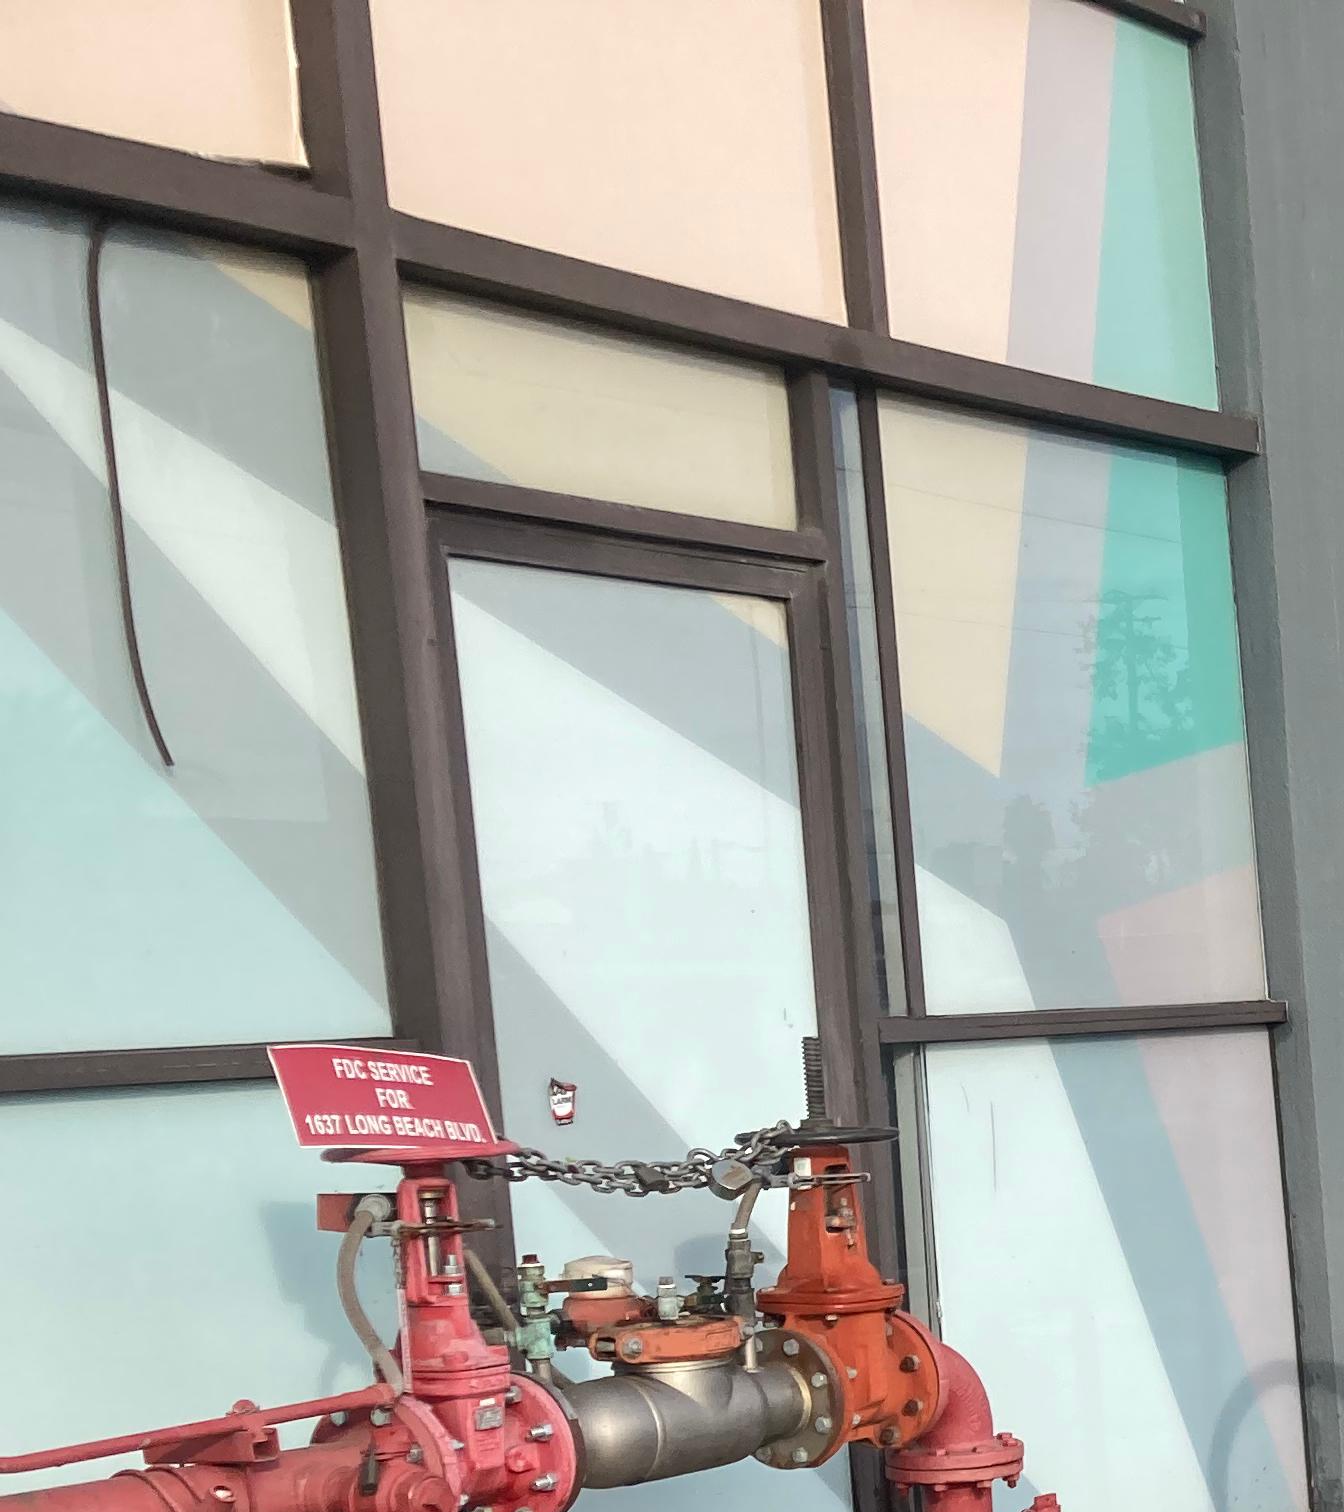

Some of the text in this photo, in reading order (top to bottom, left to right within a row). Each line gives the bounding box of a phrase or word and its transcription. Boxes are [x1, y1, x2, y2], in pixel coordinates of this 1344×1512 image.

[331, 1058, 434, 1085] FDC SERVICE
[375, 1087, 415, 1109] FOR
[305, 1114, 487, 1143] 1637 LONG BEACH BLVD.
